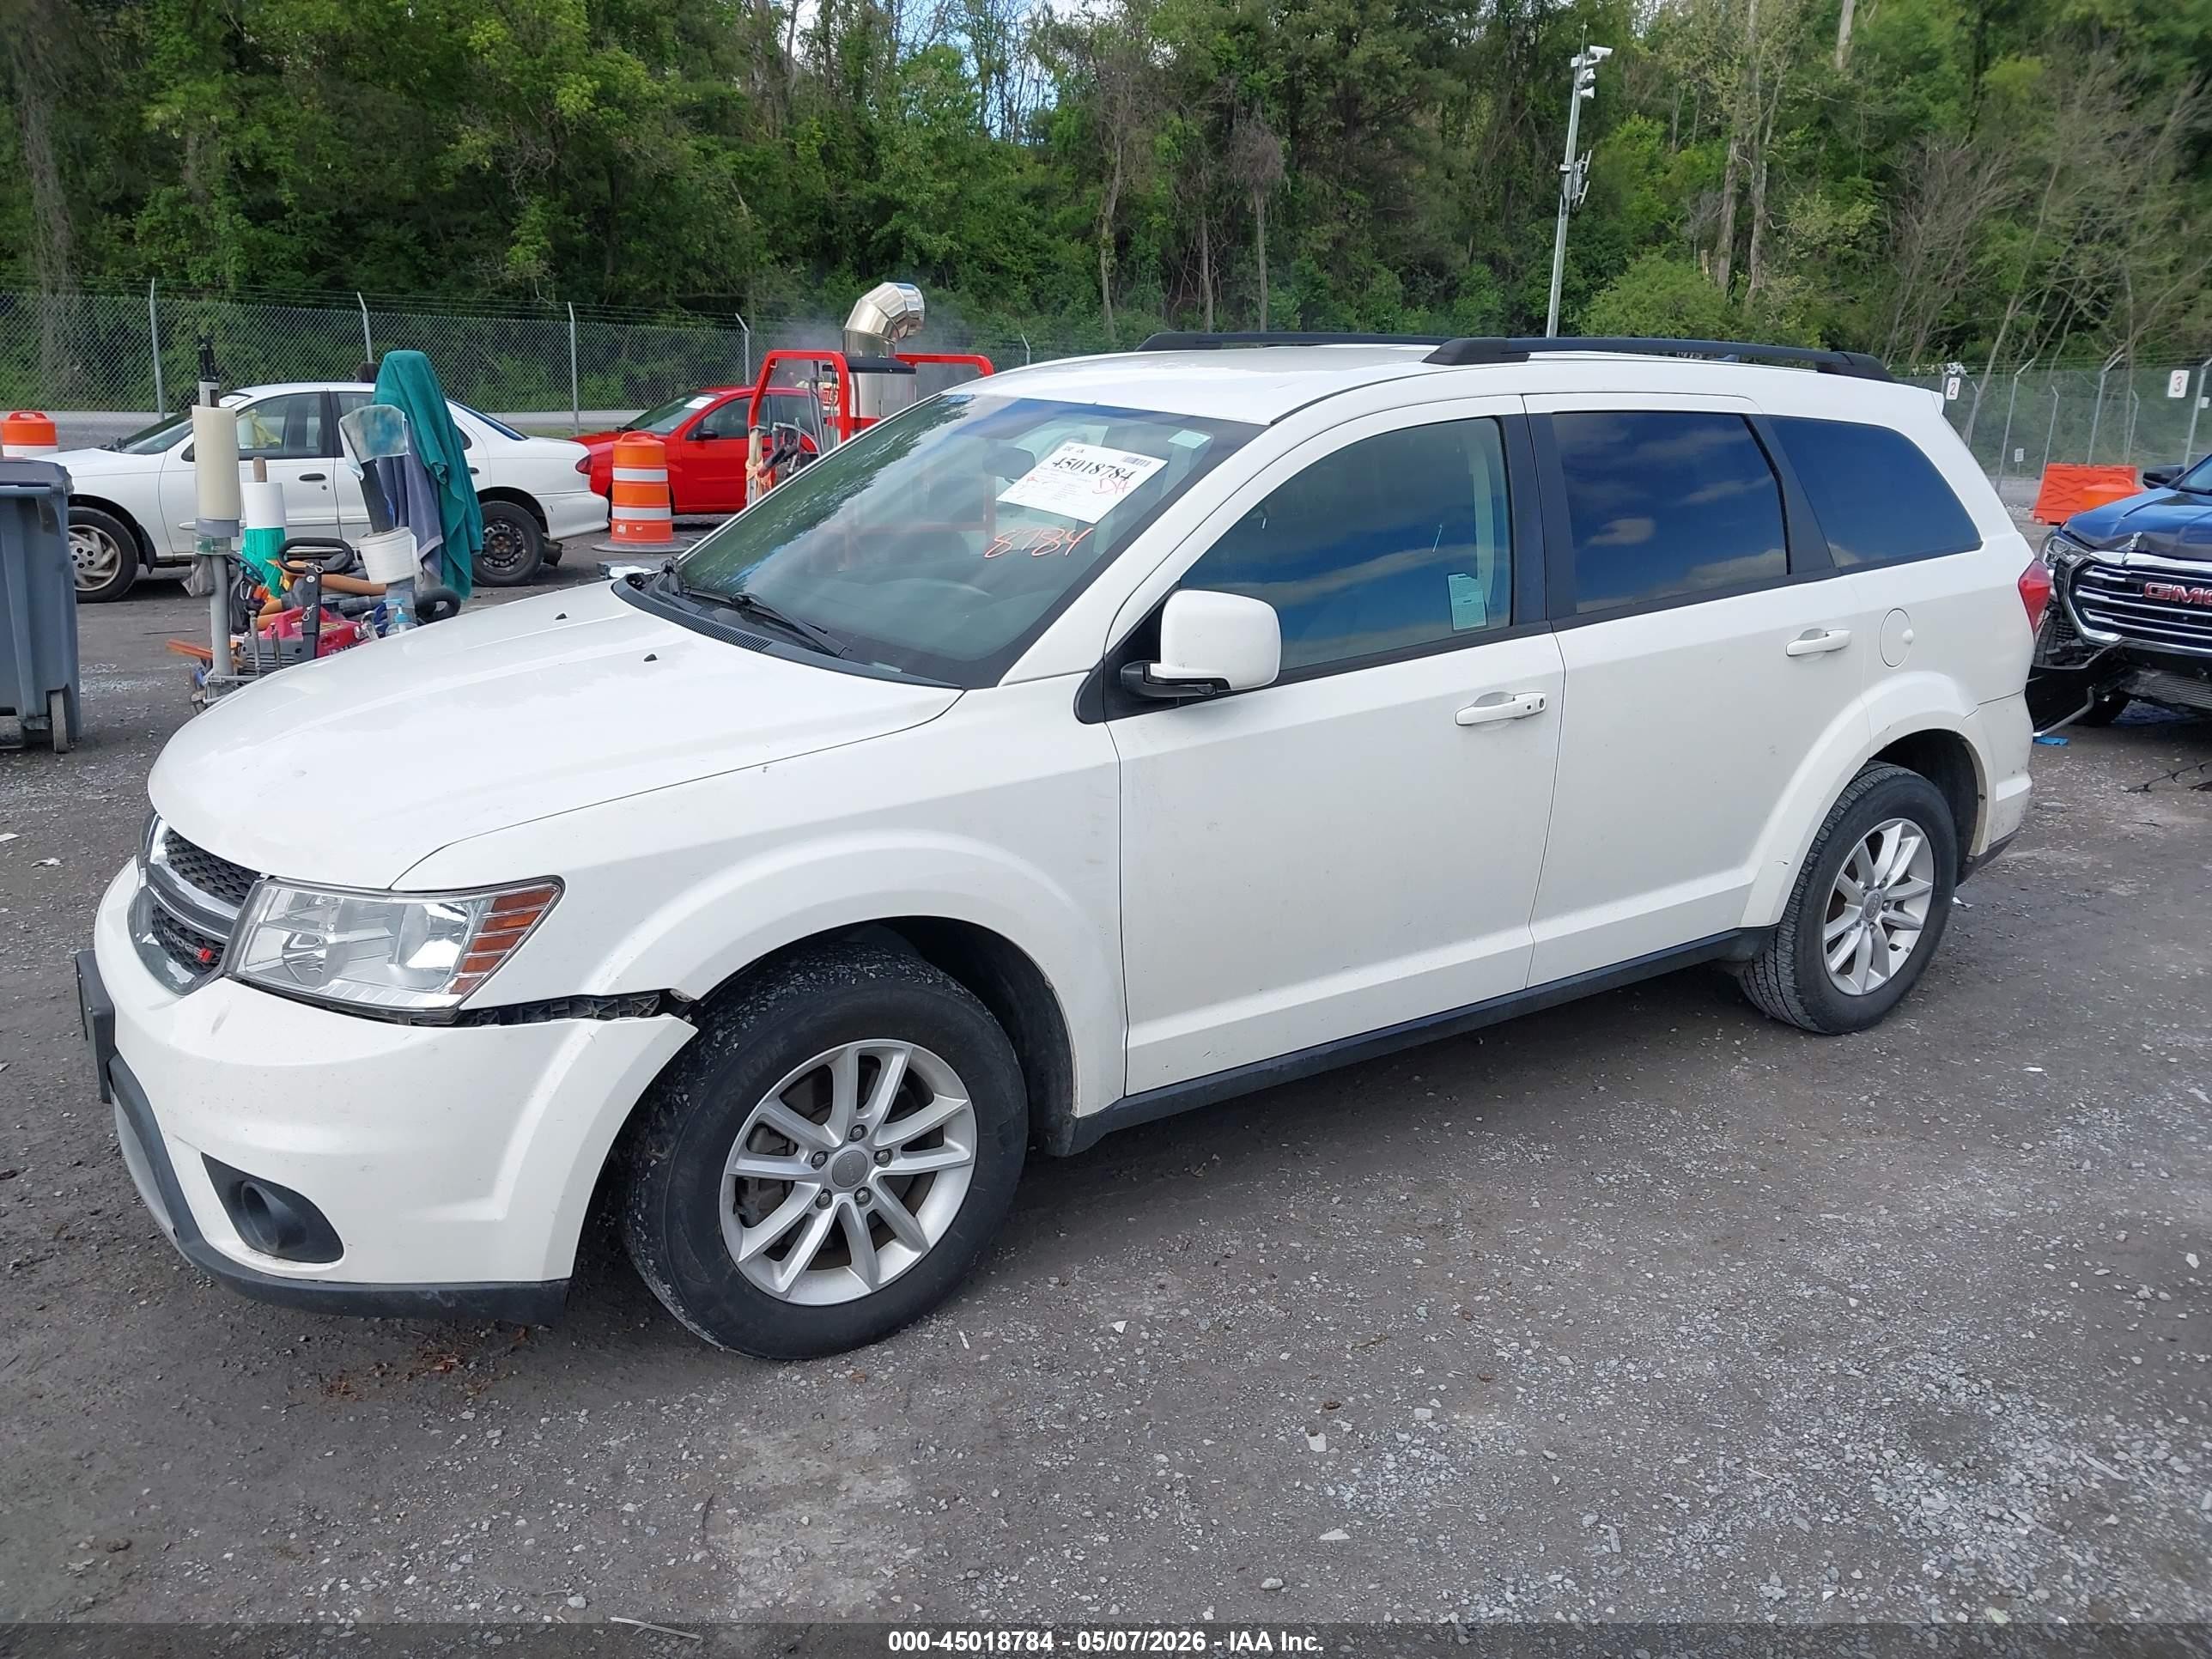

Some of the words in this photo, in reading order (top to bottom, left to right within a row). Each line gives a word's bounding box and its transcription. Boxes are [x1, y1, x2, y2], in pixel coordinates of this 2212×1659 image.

[1949, 382, 1957, 396] 2
[2174, 375, 2183, 392] 3
[1053, 457, 1138, 481] 45018784
